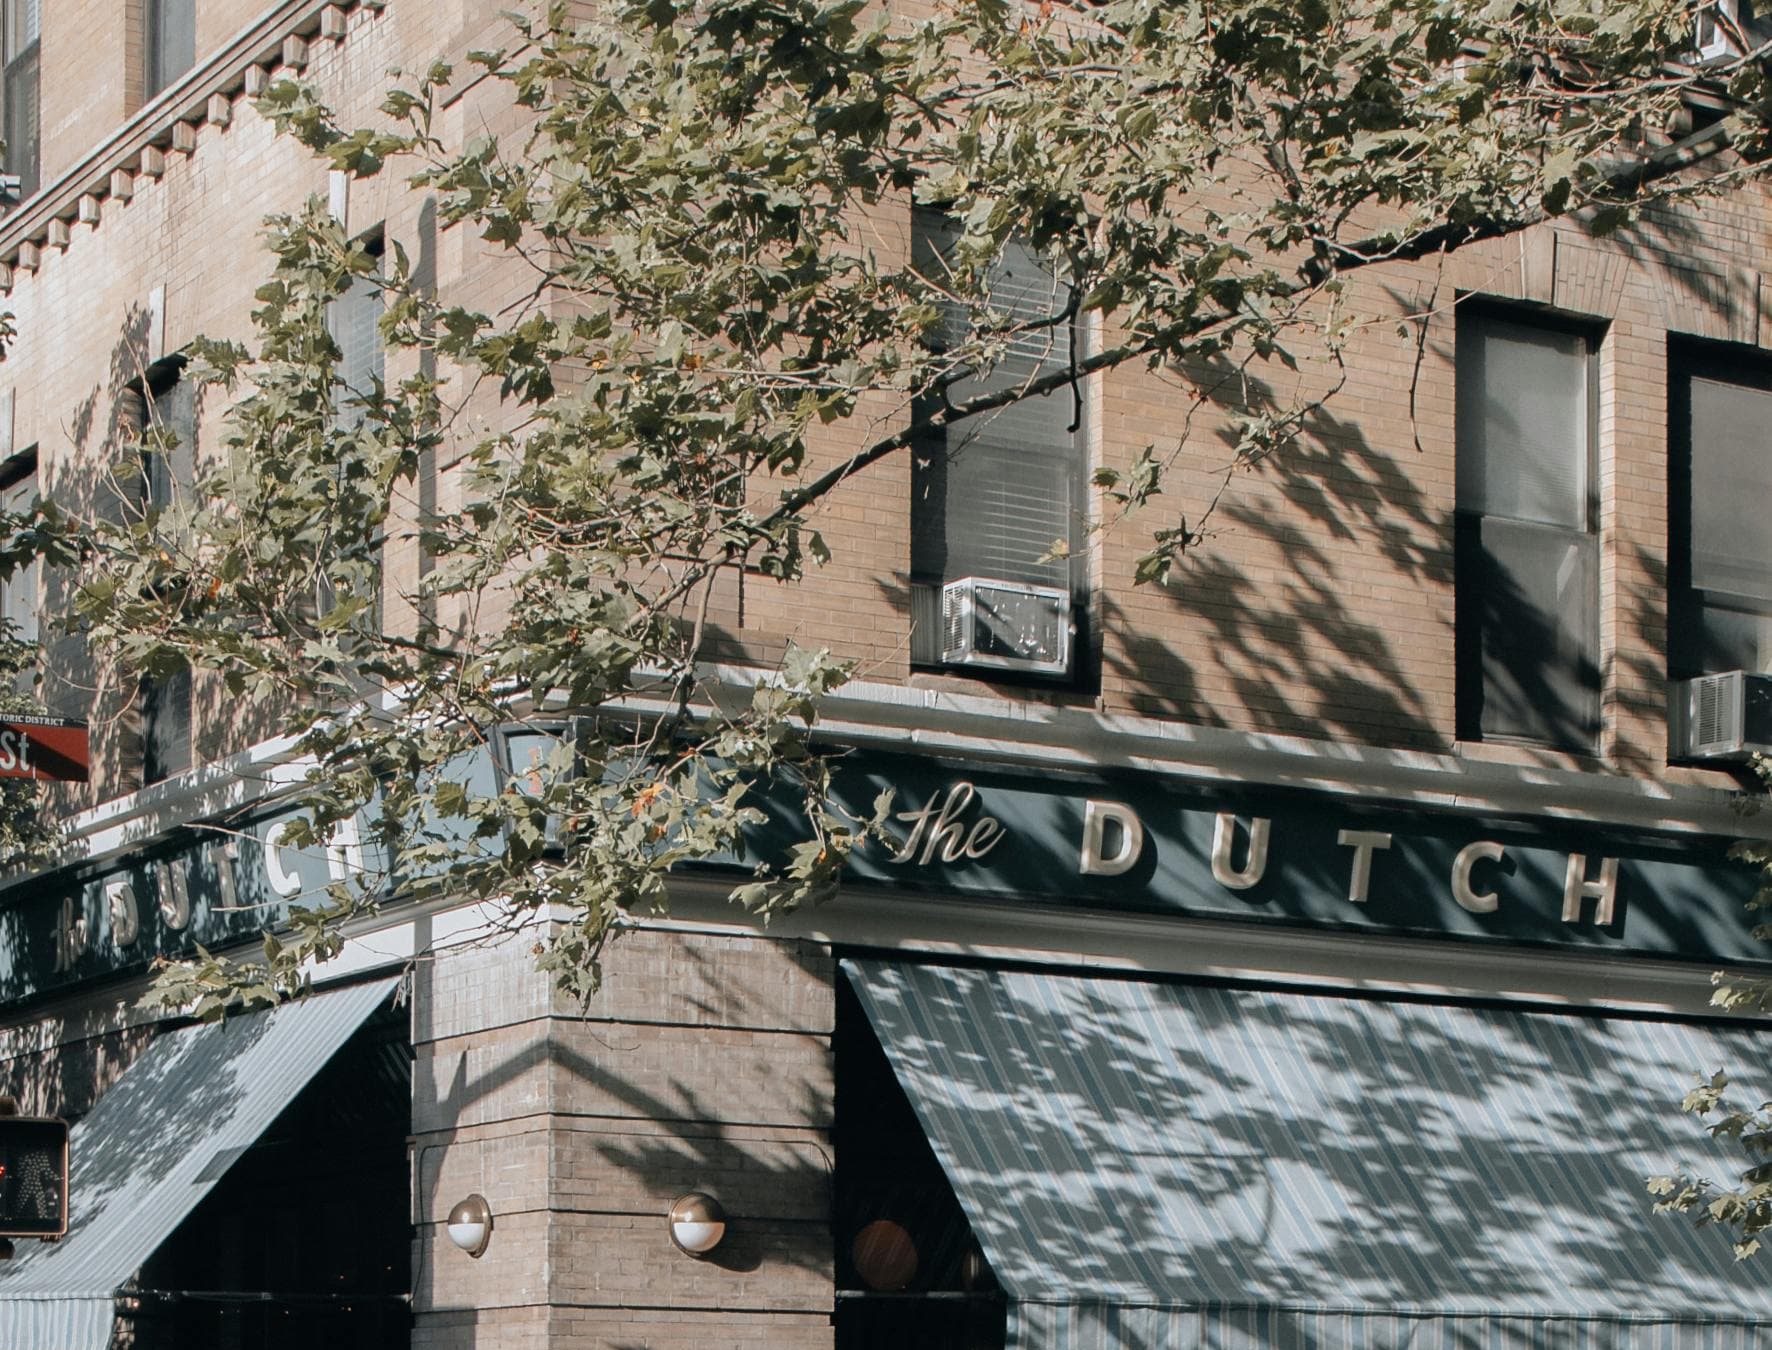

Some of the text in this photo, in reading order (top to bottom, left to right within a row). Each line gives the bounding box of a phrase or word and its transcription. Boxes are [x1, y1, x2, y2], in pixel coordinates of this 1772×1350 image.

[0, 730, 30, 772] St
[25, 716, 65, 726] DISTRICT
[105, 812, 363, 946] DUTCH
[892, 781, 1620, 925] the DUTCH
